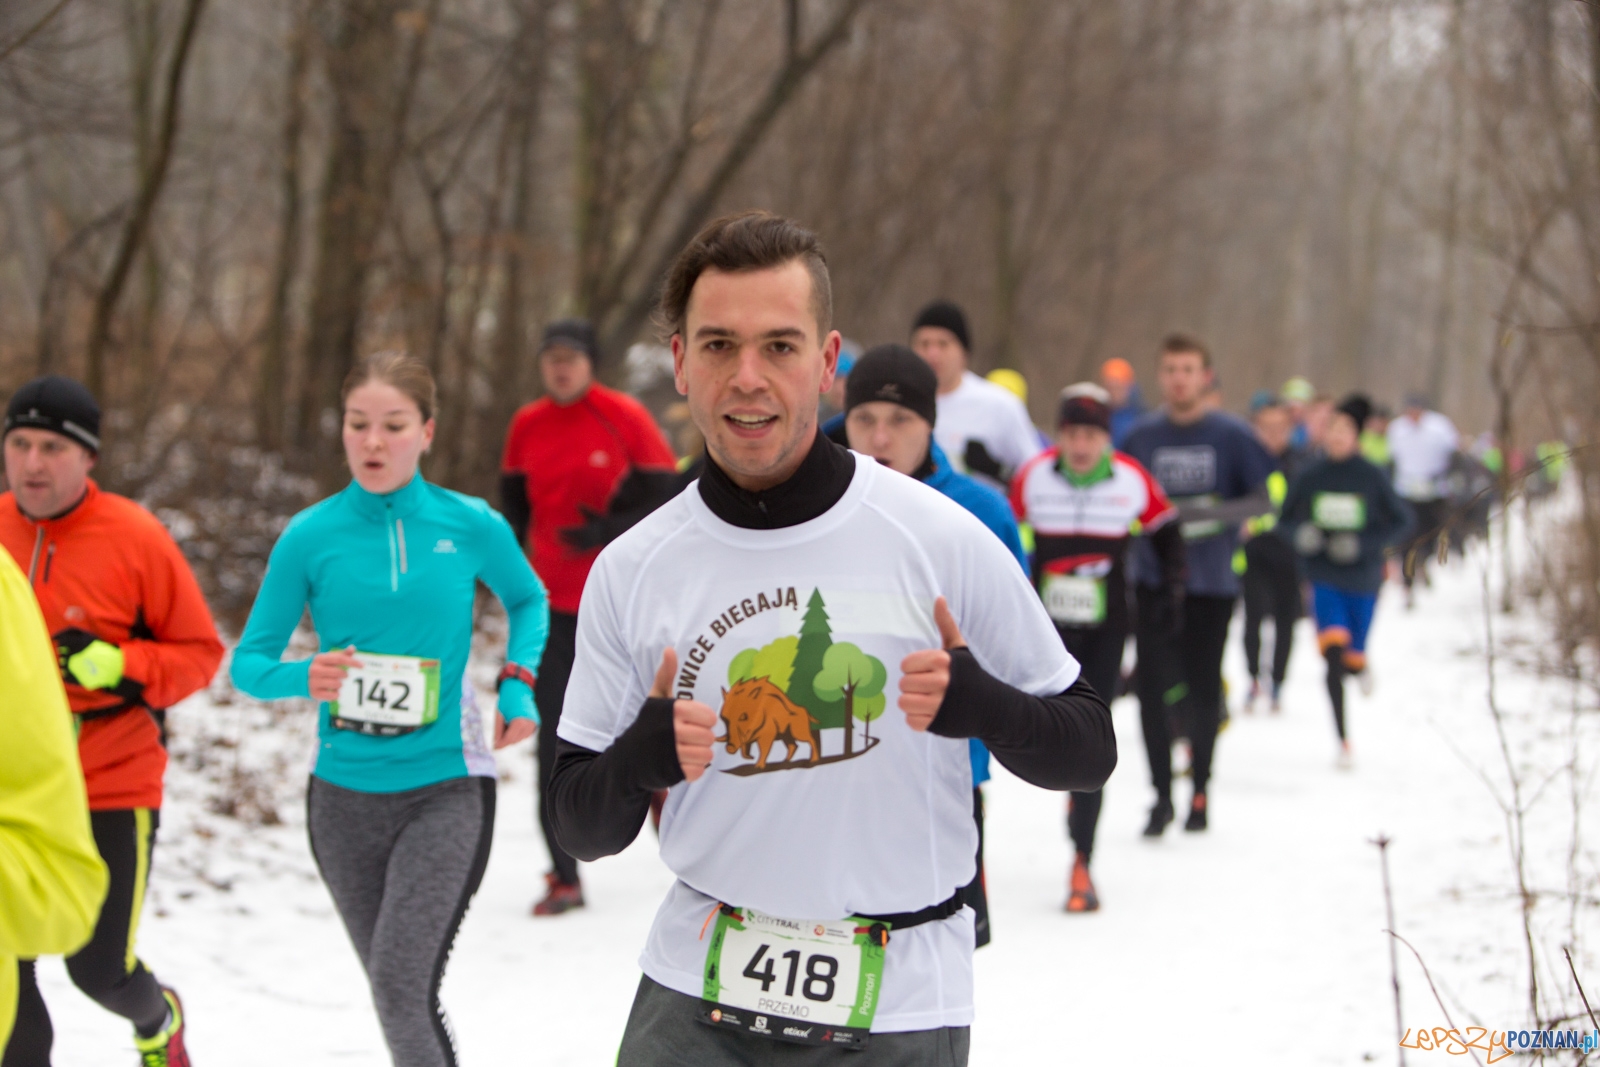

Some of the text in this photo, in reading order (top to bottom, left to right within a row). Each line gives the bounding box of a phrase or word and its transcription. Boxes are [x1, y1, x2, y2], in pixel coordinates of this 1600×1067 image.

[710, 587, 798, 638] BIEGAJĄ
[353, 677, 411, 712] 142
[743, 944, 838, 1002] 418
[858, 972, 876, 1016] Poznań
[757, 997, 810, 1018] PRZEMO
